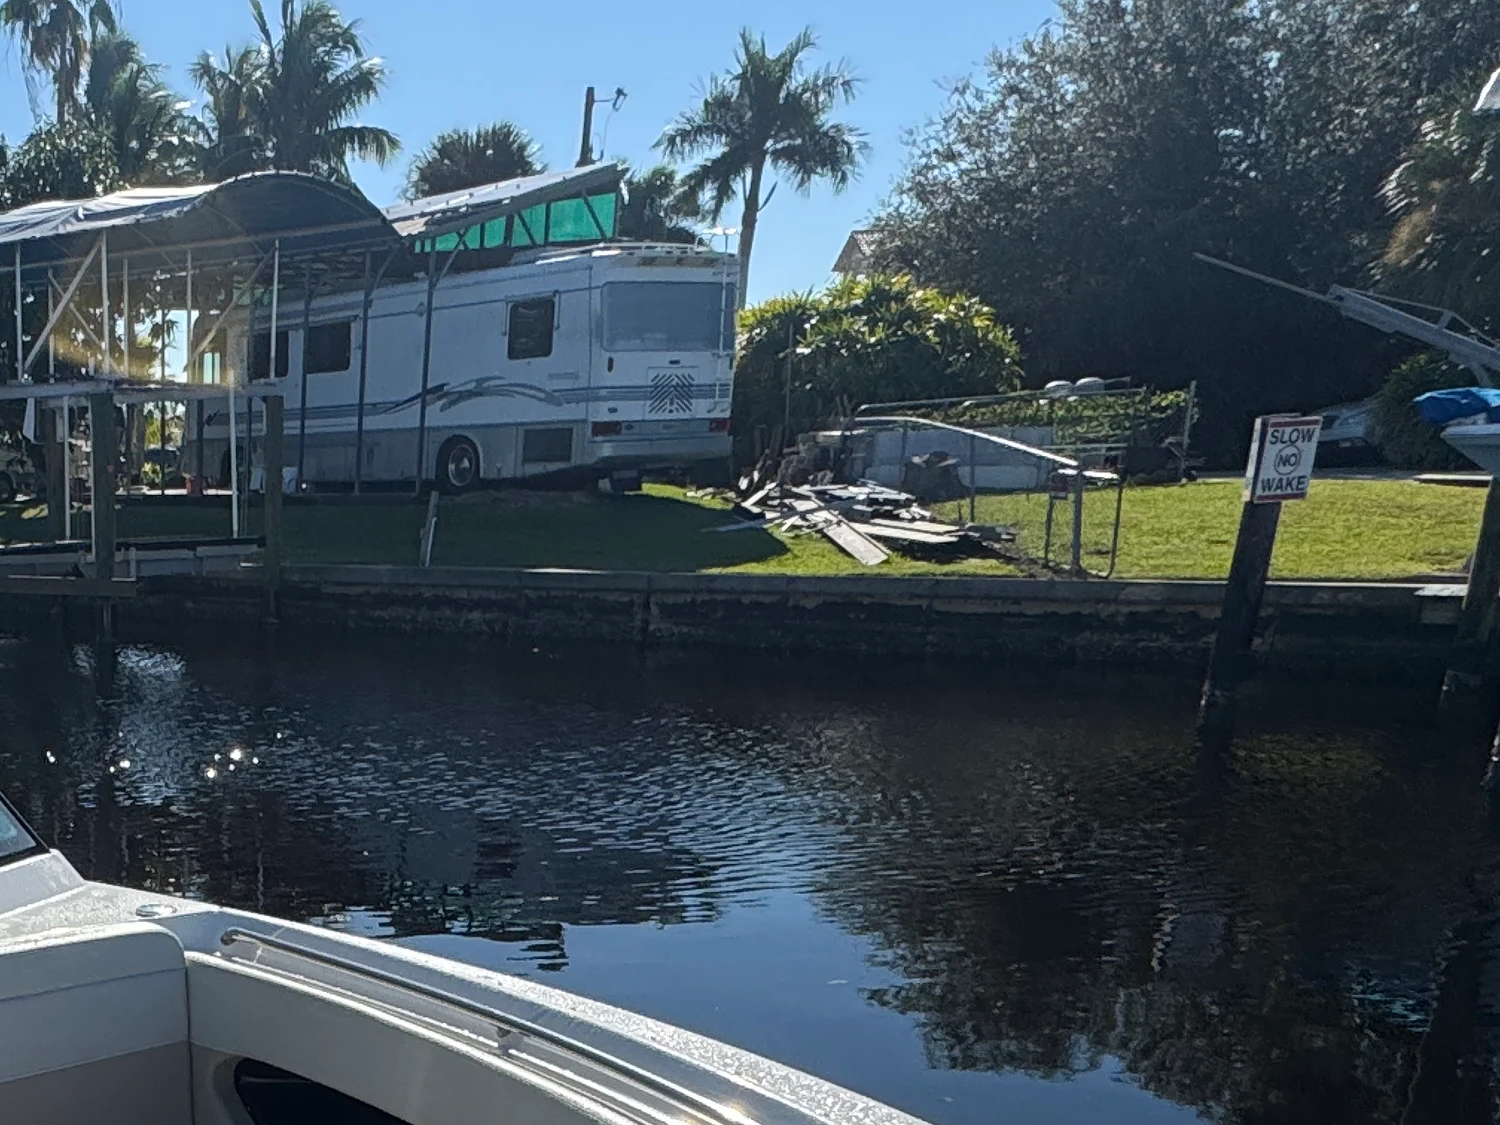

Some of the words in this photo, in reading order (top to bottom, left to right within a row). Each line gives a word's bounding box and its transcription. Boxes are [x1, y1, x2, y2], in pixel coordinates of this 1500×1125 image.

[1269, 428, 1315, 444] SLOW
[1277, 453, 1297, 467] NO
[1262, 476, 1306, 492] WAKE
